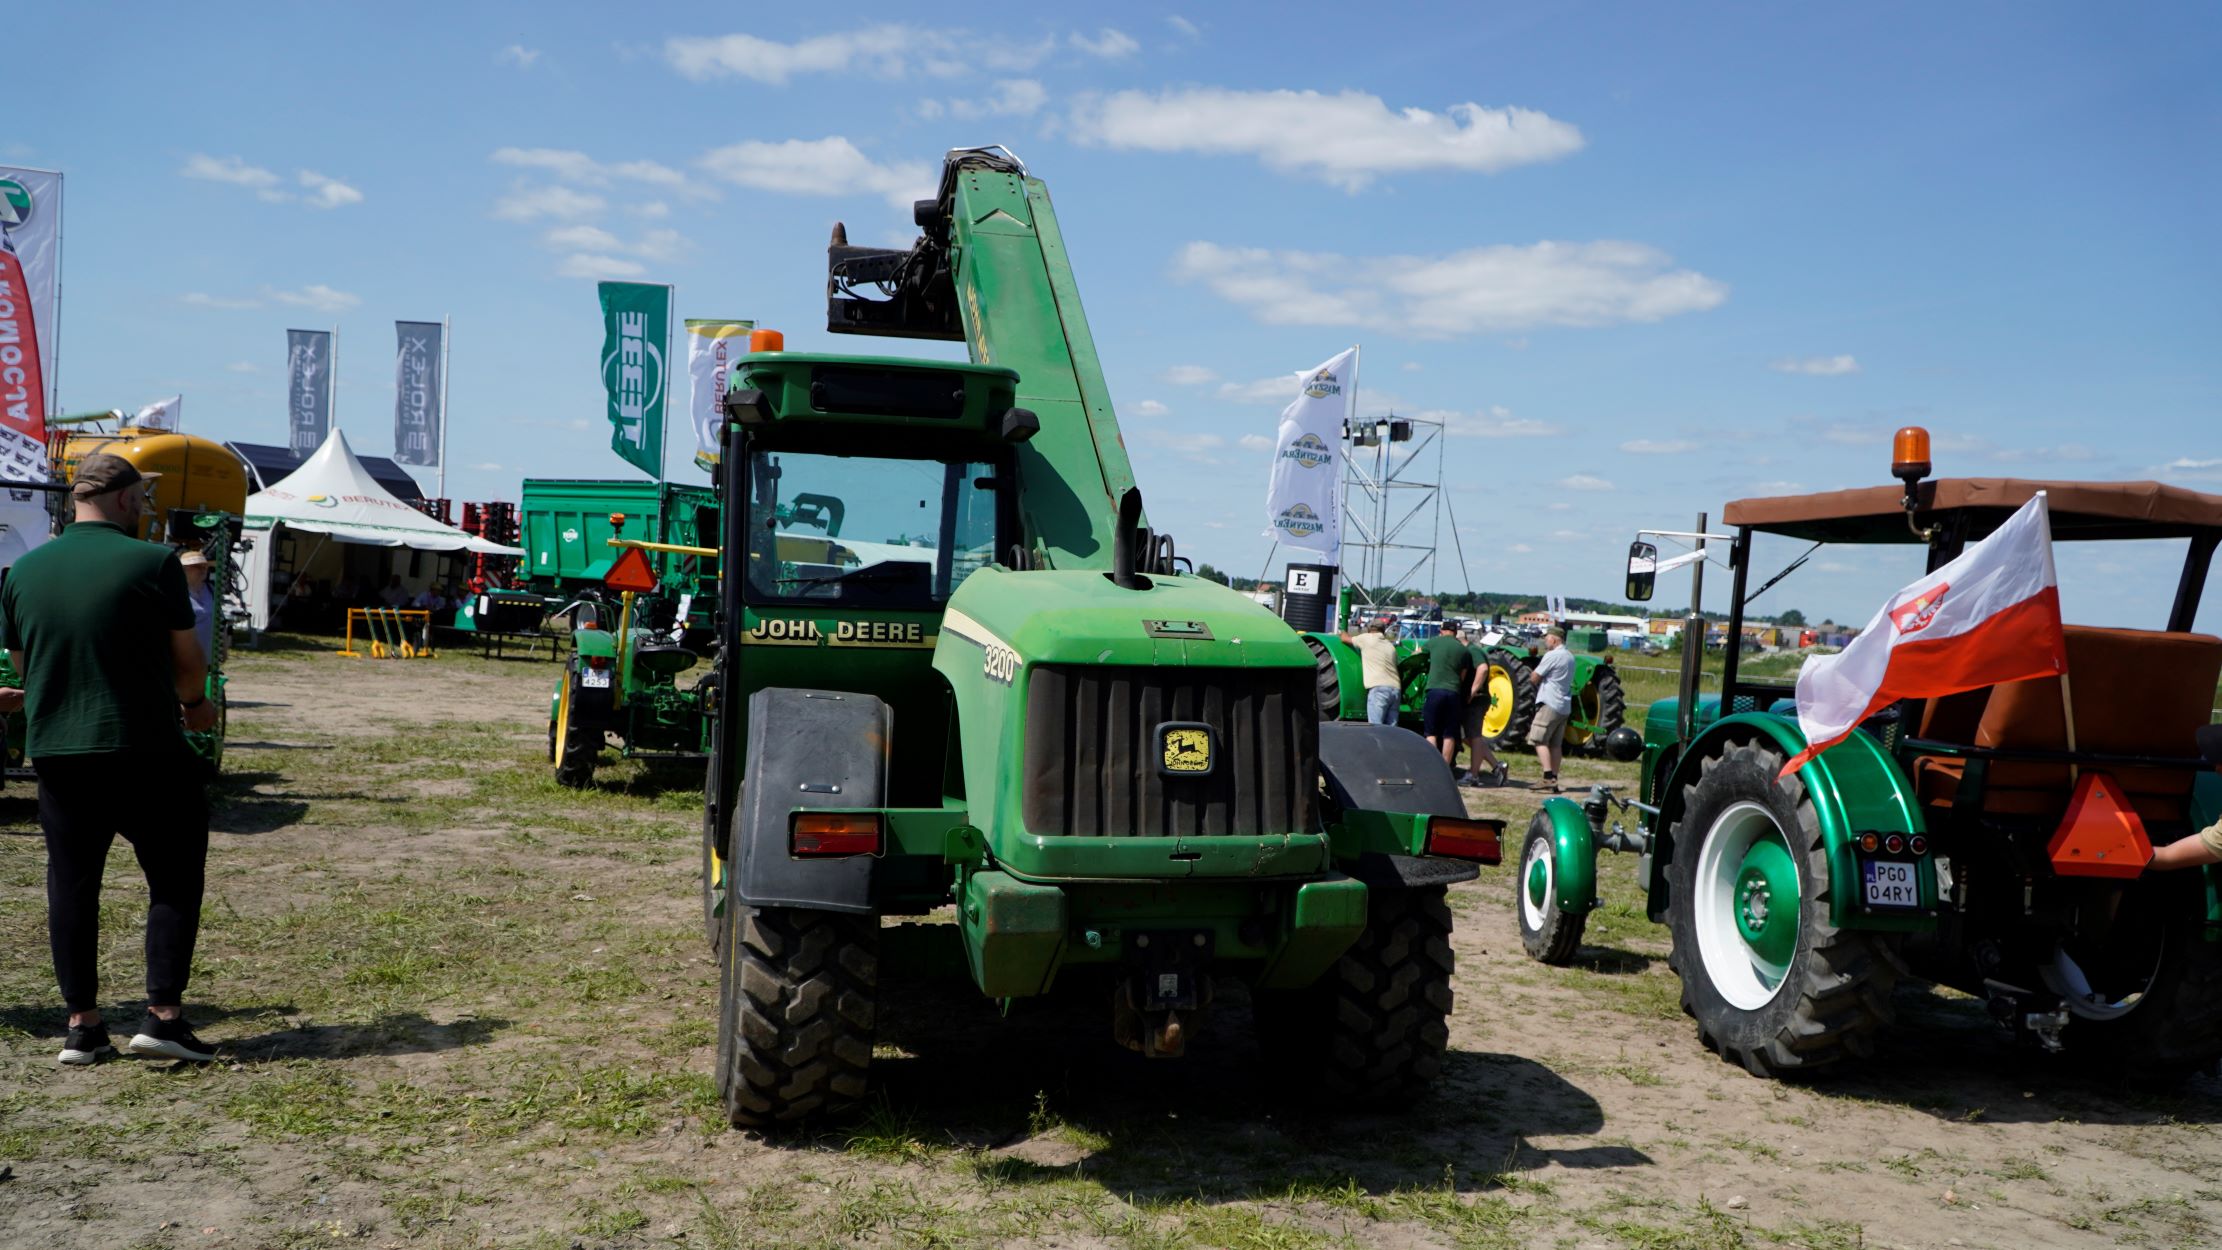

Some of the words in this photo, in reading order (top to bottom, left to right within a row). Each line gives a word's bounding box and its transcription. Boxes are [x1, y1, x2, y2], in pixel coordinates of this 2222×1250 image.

[1296, 573, 1307, 587] E
[751, 619, 824, 639] JOHN
[837, 621, 922, 641] DEERE
[984, 644, 1014, 682] 3200
[1877, 866, 1906, 882] PGO
[1870, 885, 1912, 902] 04RY
